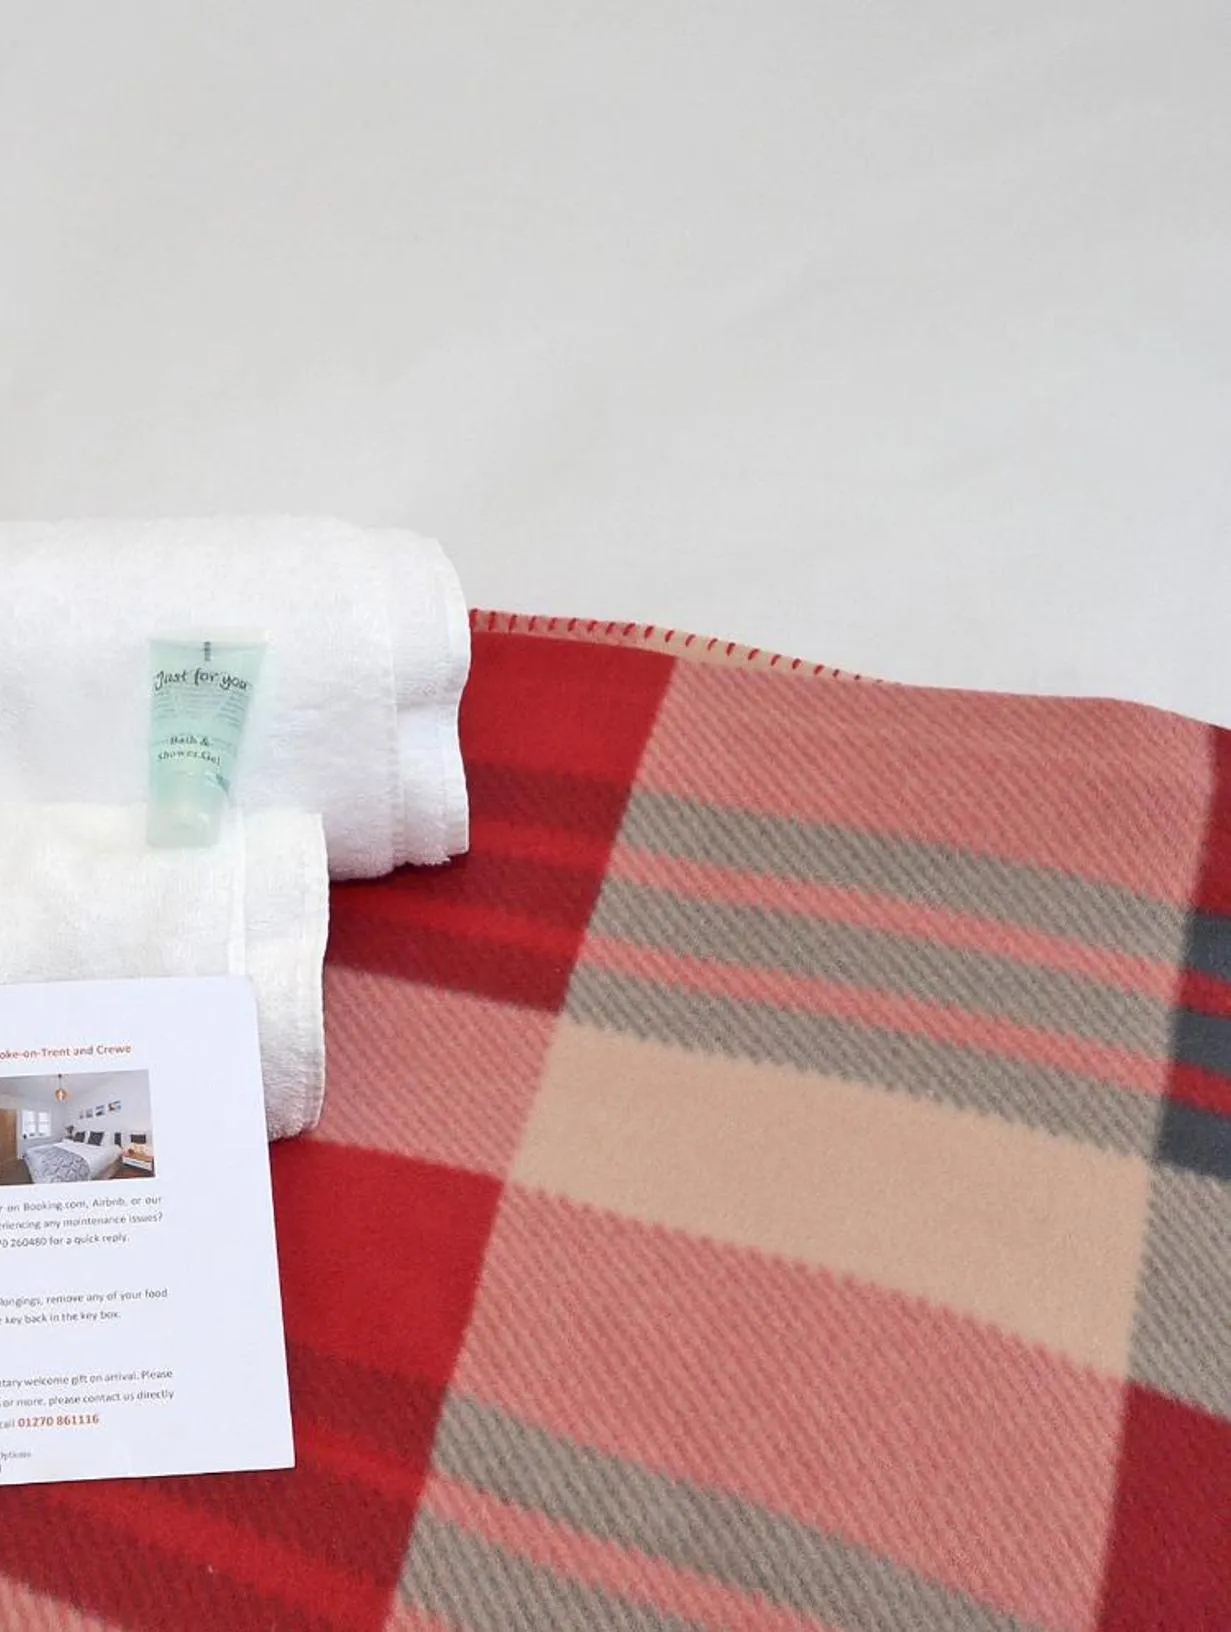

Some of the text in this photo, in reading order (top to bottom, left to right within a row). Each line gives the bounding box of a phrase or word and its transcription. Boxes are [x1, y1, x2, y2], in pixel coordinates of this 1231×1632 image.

[154, 667, 248, 691] Just for you
[200, 736, 210, 747] &
[73, 1046, 93, 1056] and
[96, 1045, 132, 1054] Crewe
[7, 1205, 19, 1213] on
[130, 1198, 141, 1206] or
[43, 1220, 60, 1230] any
[129, 1212, 162, 1223] issues?
[49, 1236, 63, 1246] for
[73, 1234, 99, 1247] quick
[86, 1294, 104, 1304] any
[106, 1291, 118, 1301] of
[120, 1292, 141, 1303] your
[144, 1288, 167, 1299] food
[4, 1316, 21, 1327] key
[80, 1311, 97, 1323] key
[23, 1376, 69, 1386] welcome
[141, 1370, 172, 1379] Please
[48, 1396, 80, 1408] please
[136, 1390, 174, 1401] directly
[17, 1417, 53, 1428] 01270
[56, 1415, 99, 1426] 861116
